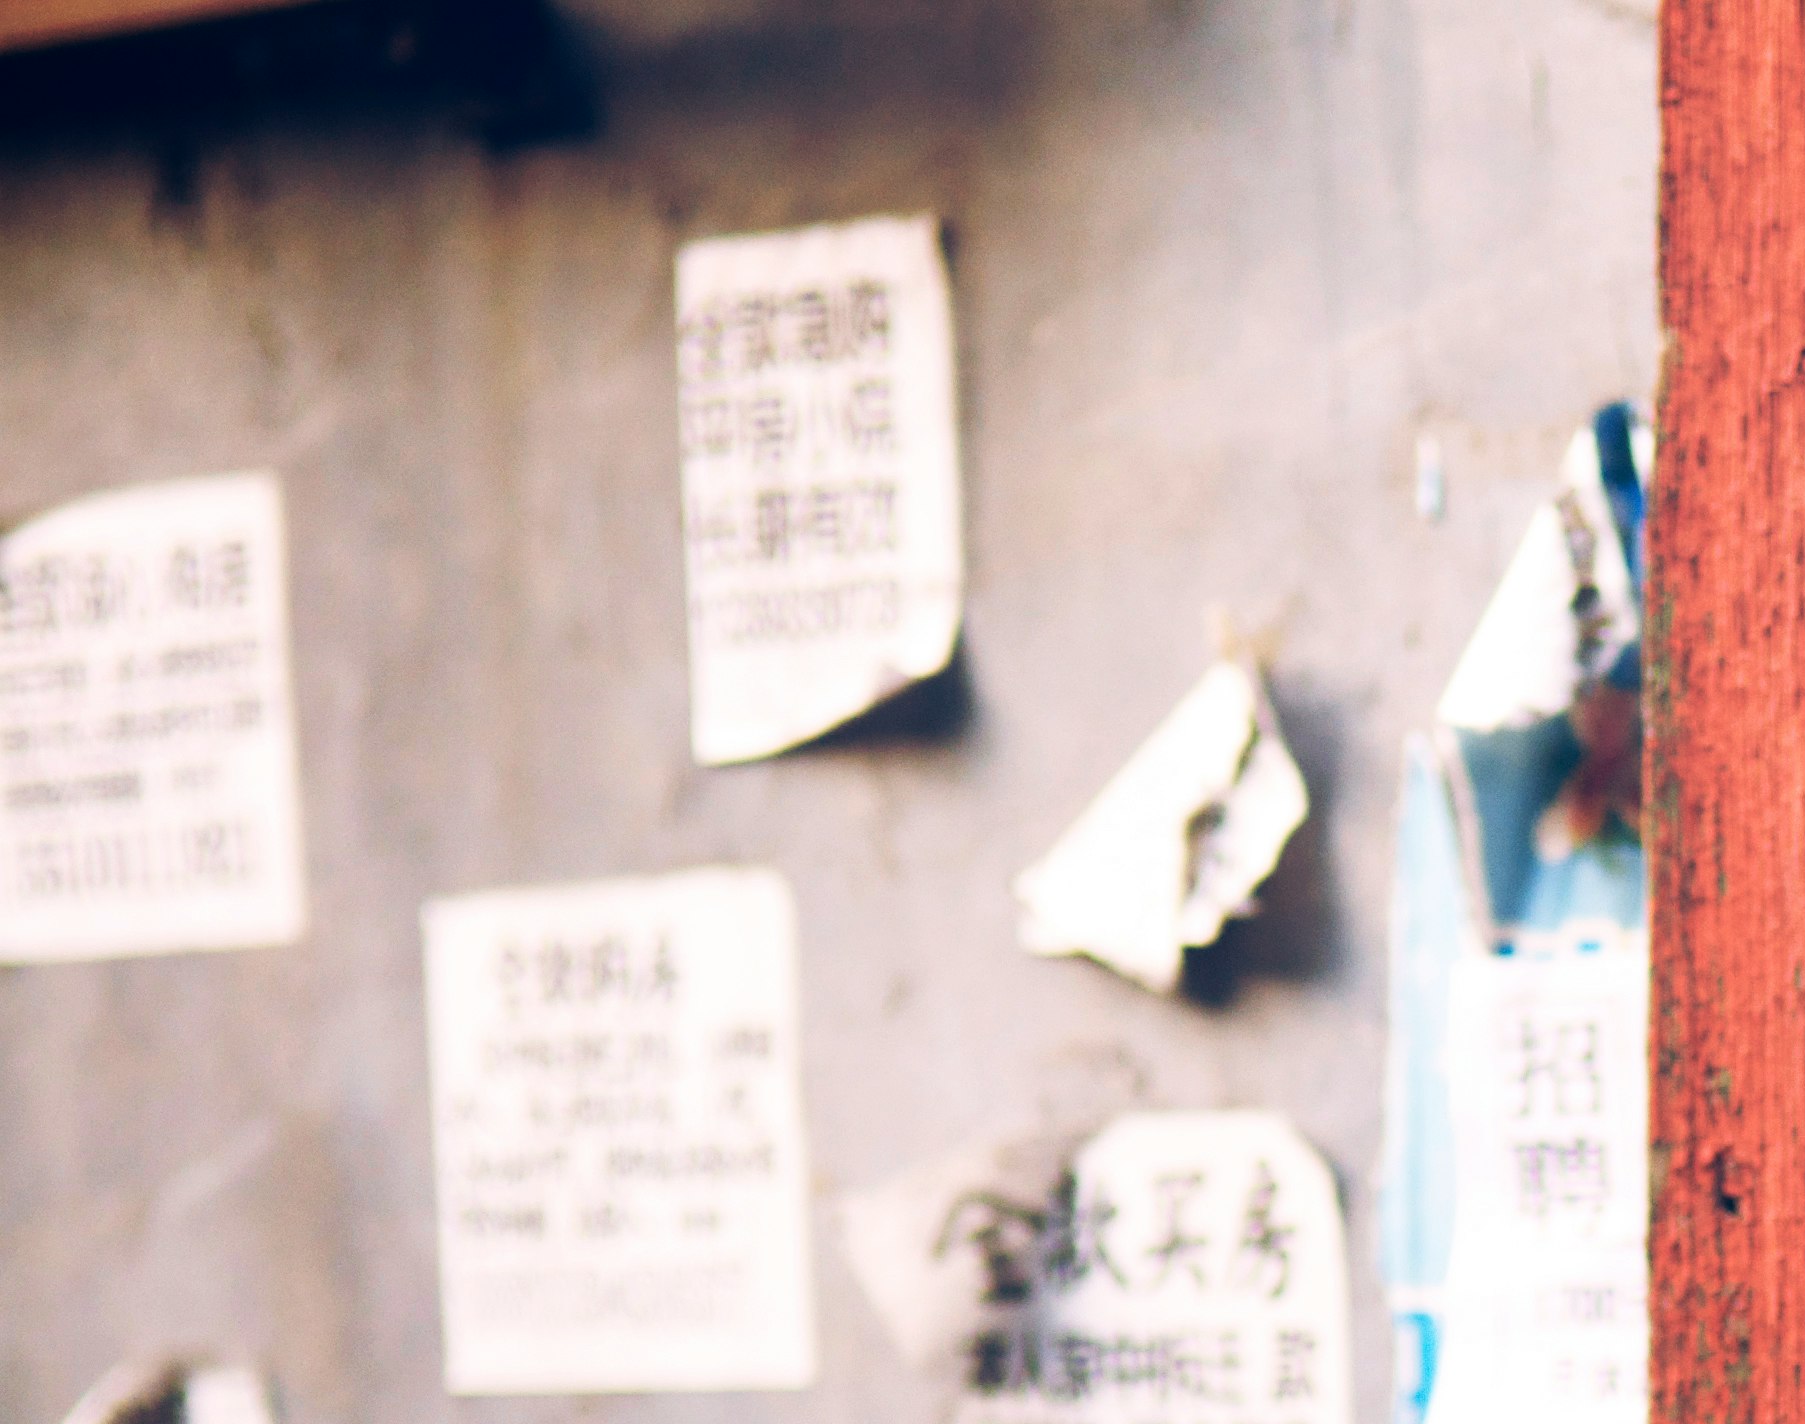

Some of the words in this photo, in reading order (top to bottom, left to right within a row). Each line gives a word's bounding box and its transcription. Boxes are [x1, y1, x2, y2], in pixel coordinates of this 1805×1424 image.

[1513, 1016, 1610, 1231] 招聘
[934, 1159, 1294, 1301] 全款买房
